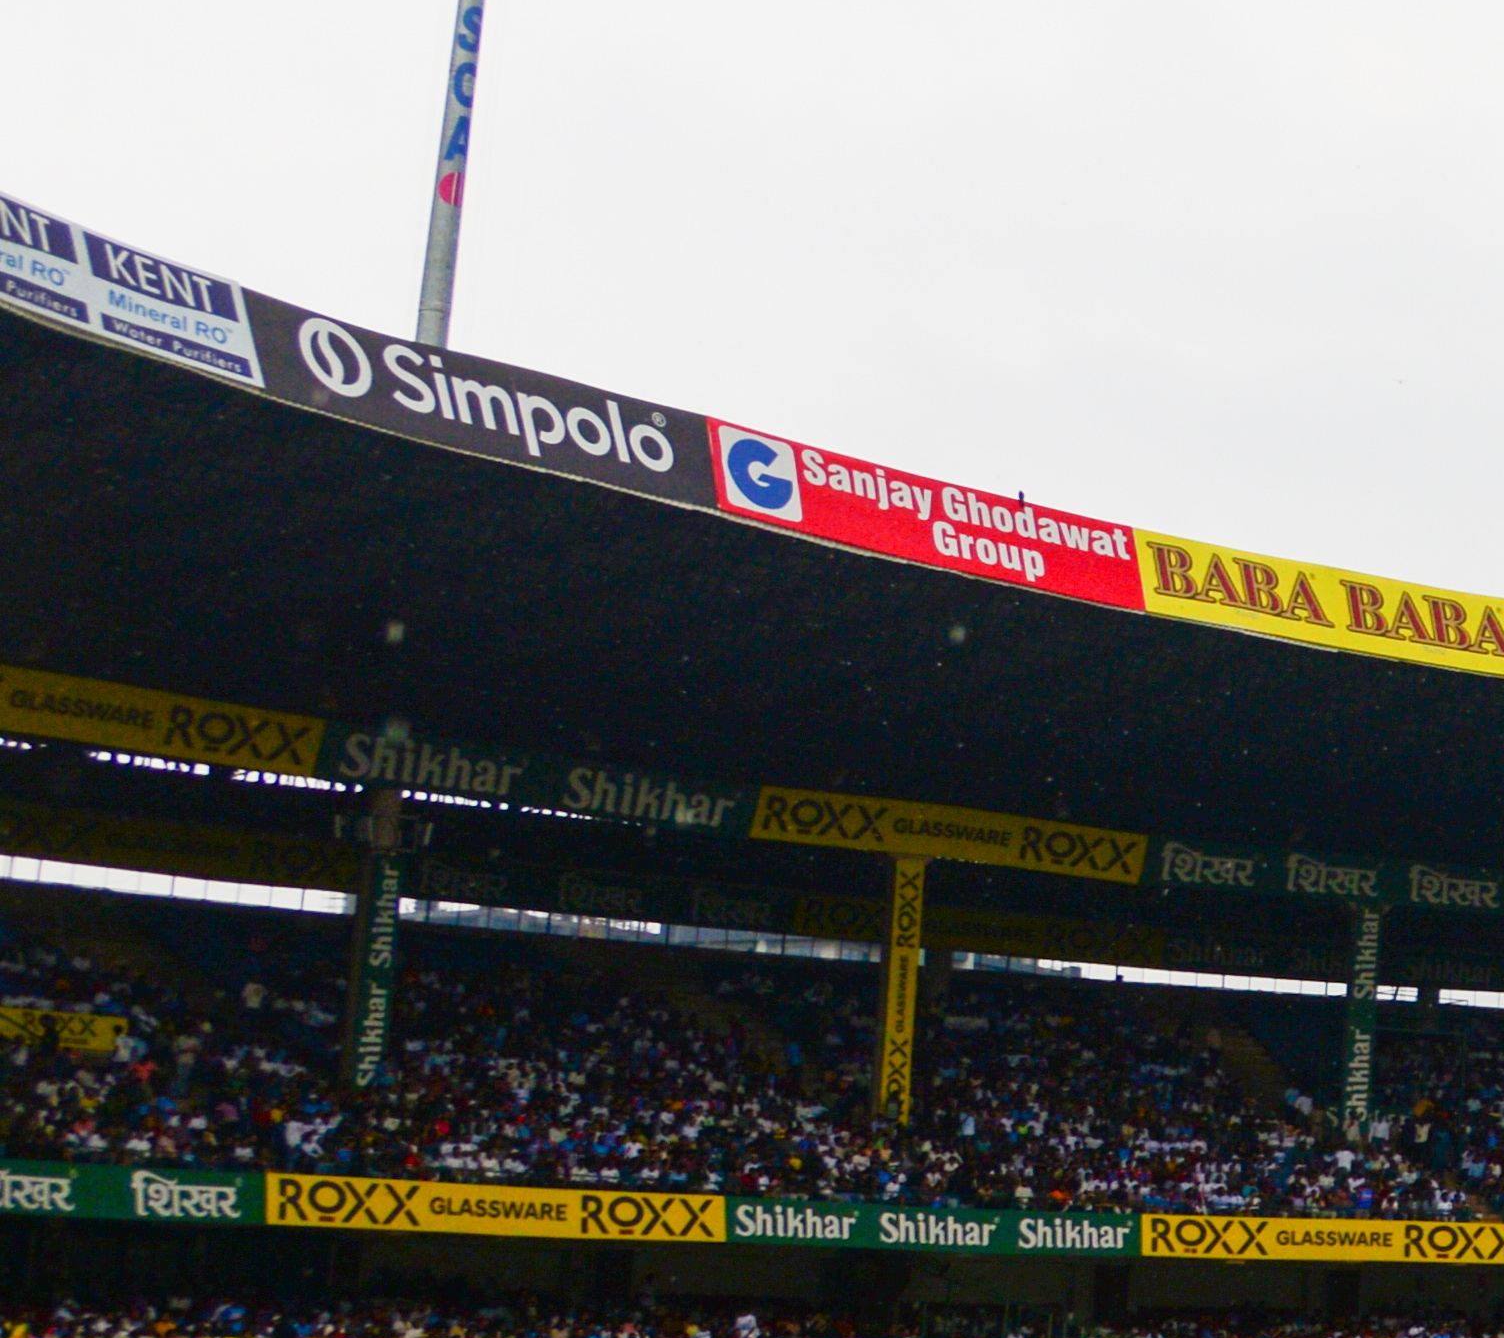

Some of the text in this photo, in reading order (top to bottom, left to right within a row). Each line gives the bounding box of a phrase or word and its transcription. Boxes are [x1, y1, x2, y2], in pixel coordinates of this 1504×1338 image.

[103, 242, 216, 314] KENT
[107, 288, 188, 333] Mineral
[111, 317, 243, 375] Water Purifiers
[803, 449, 1131, 562] Sanjay Ghodawat
[932, 519, 1046, 581] Group
[1148, 540, 1328, 627] BABA
[11, 689, 312, 766] GLASSWARE ROXX
[338, 733, 737, 829] Shikhar Shikhar
[762, 796, 1136, 874] ROXX GLASSWARE ROXX
[1162, 843, 1255, 886] शिखर
[130, 1170, 242, 1219] शिखर
[278, 1179, 715, 1237] ROXX GLASSWARE ROXX
[734, 1204, 1132, 1251] Shikhar Shikhar Shikhar
[1151, 1219, 1268, 1256] ROXX
[1275, 1229, 1393, 1249] GLASSWARE
